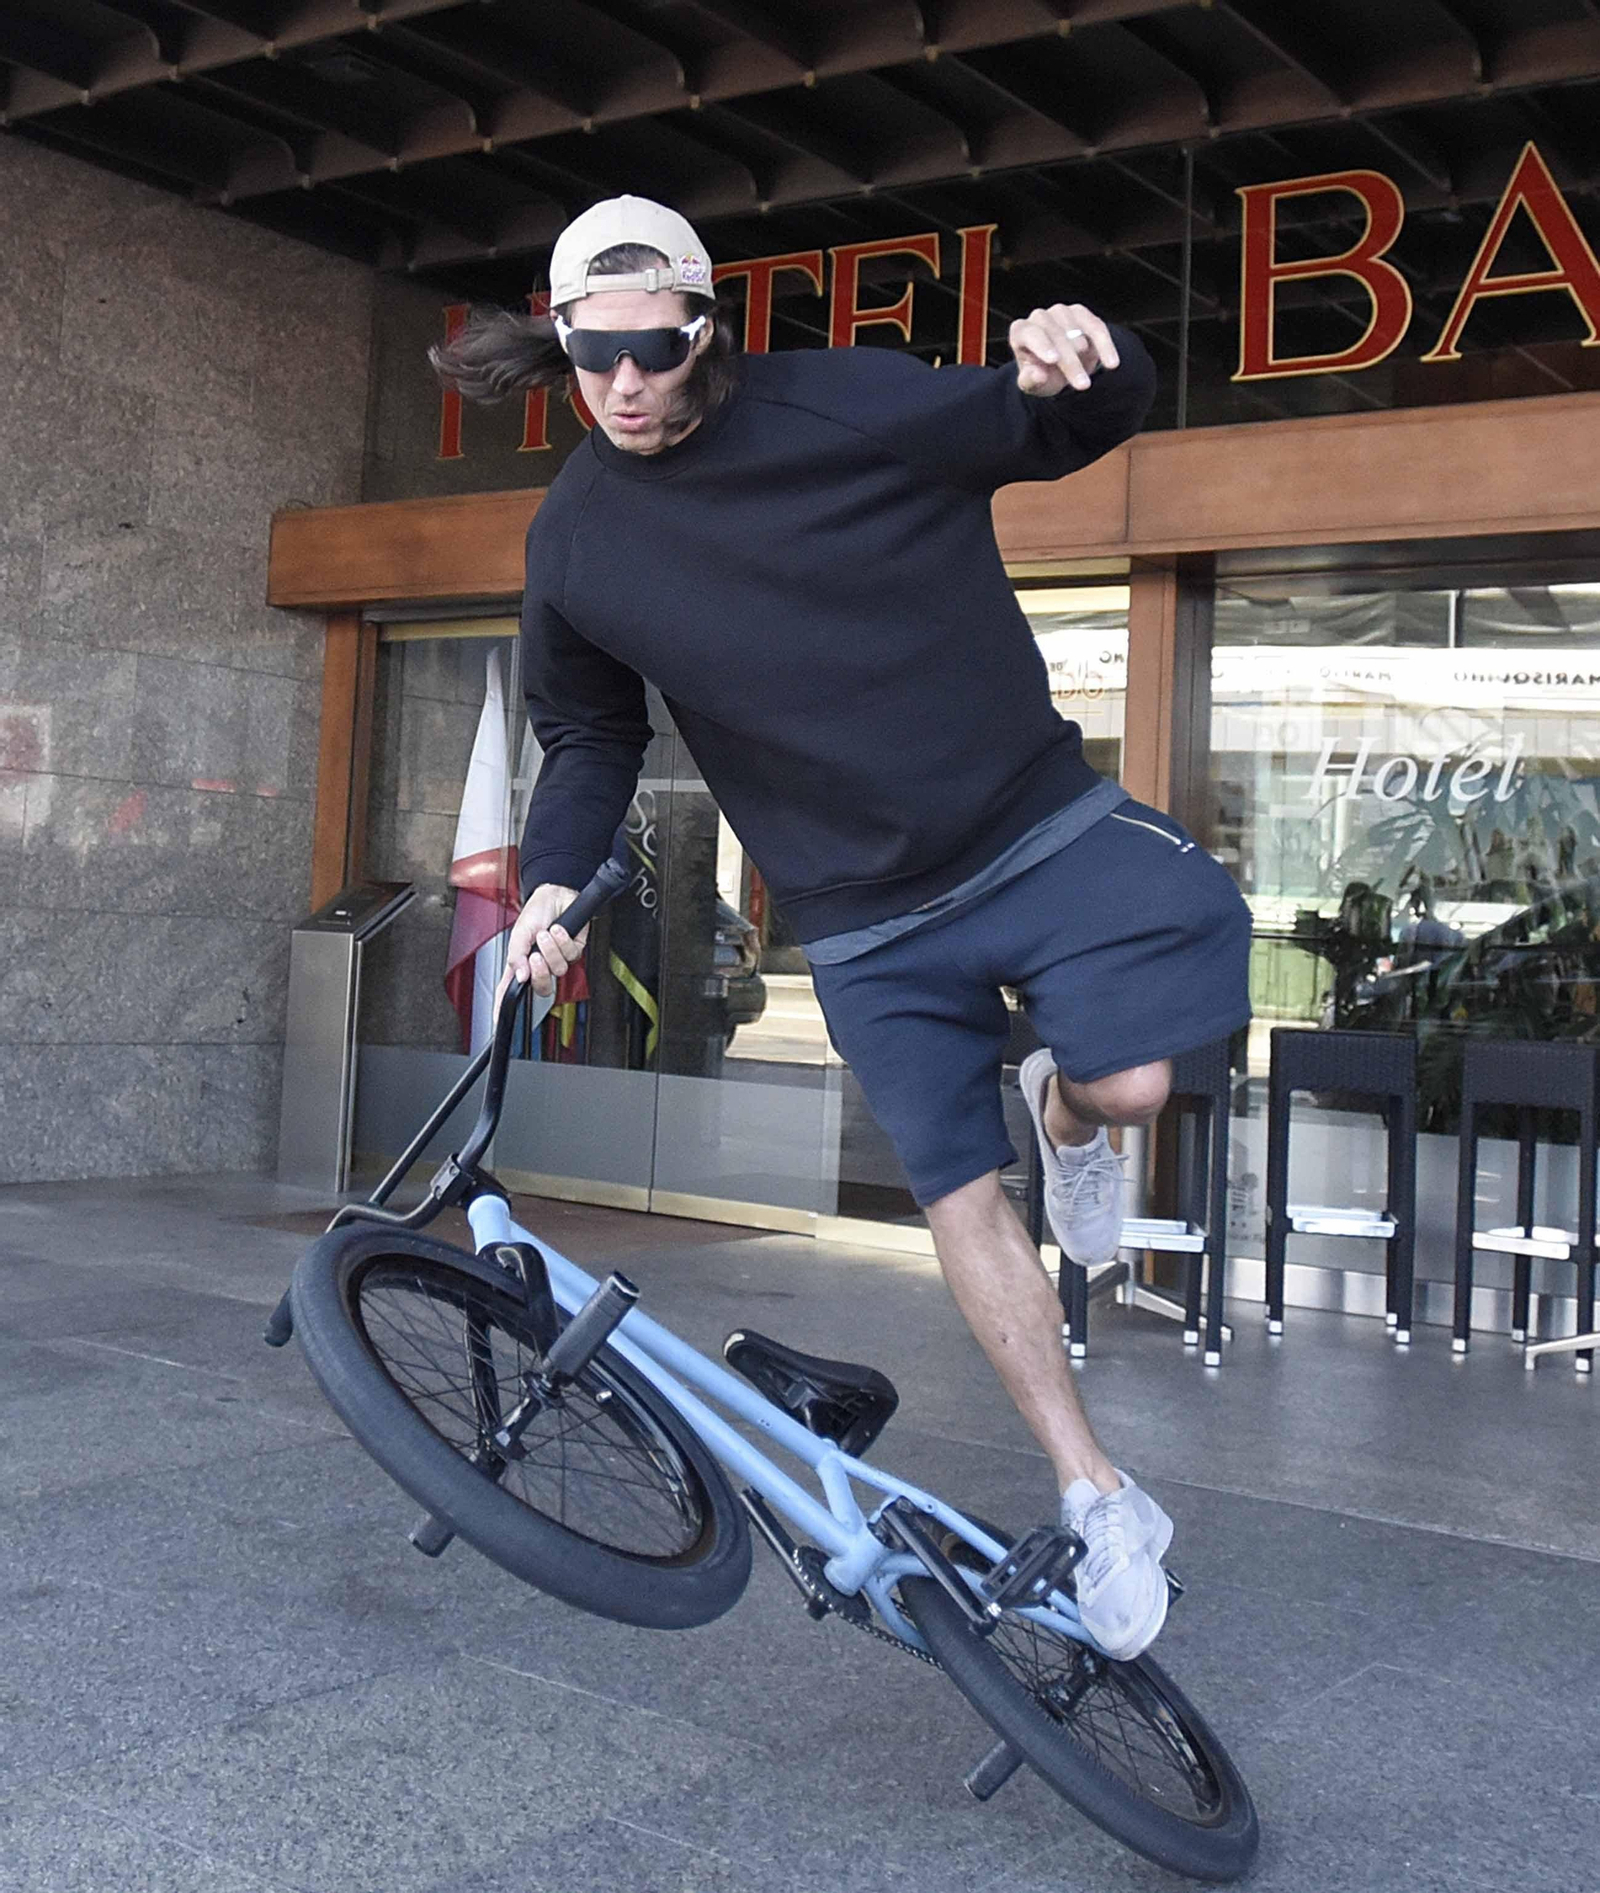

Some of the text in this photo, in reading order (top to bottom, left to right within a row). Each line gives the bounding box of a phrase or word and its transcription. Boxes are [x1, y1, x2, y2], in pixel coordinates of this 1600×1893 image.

[435, 140, 1600, 459] HTEL BA
[1301, 731, 1526, 802] Hotel
